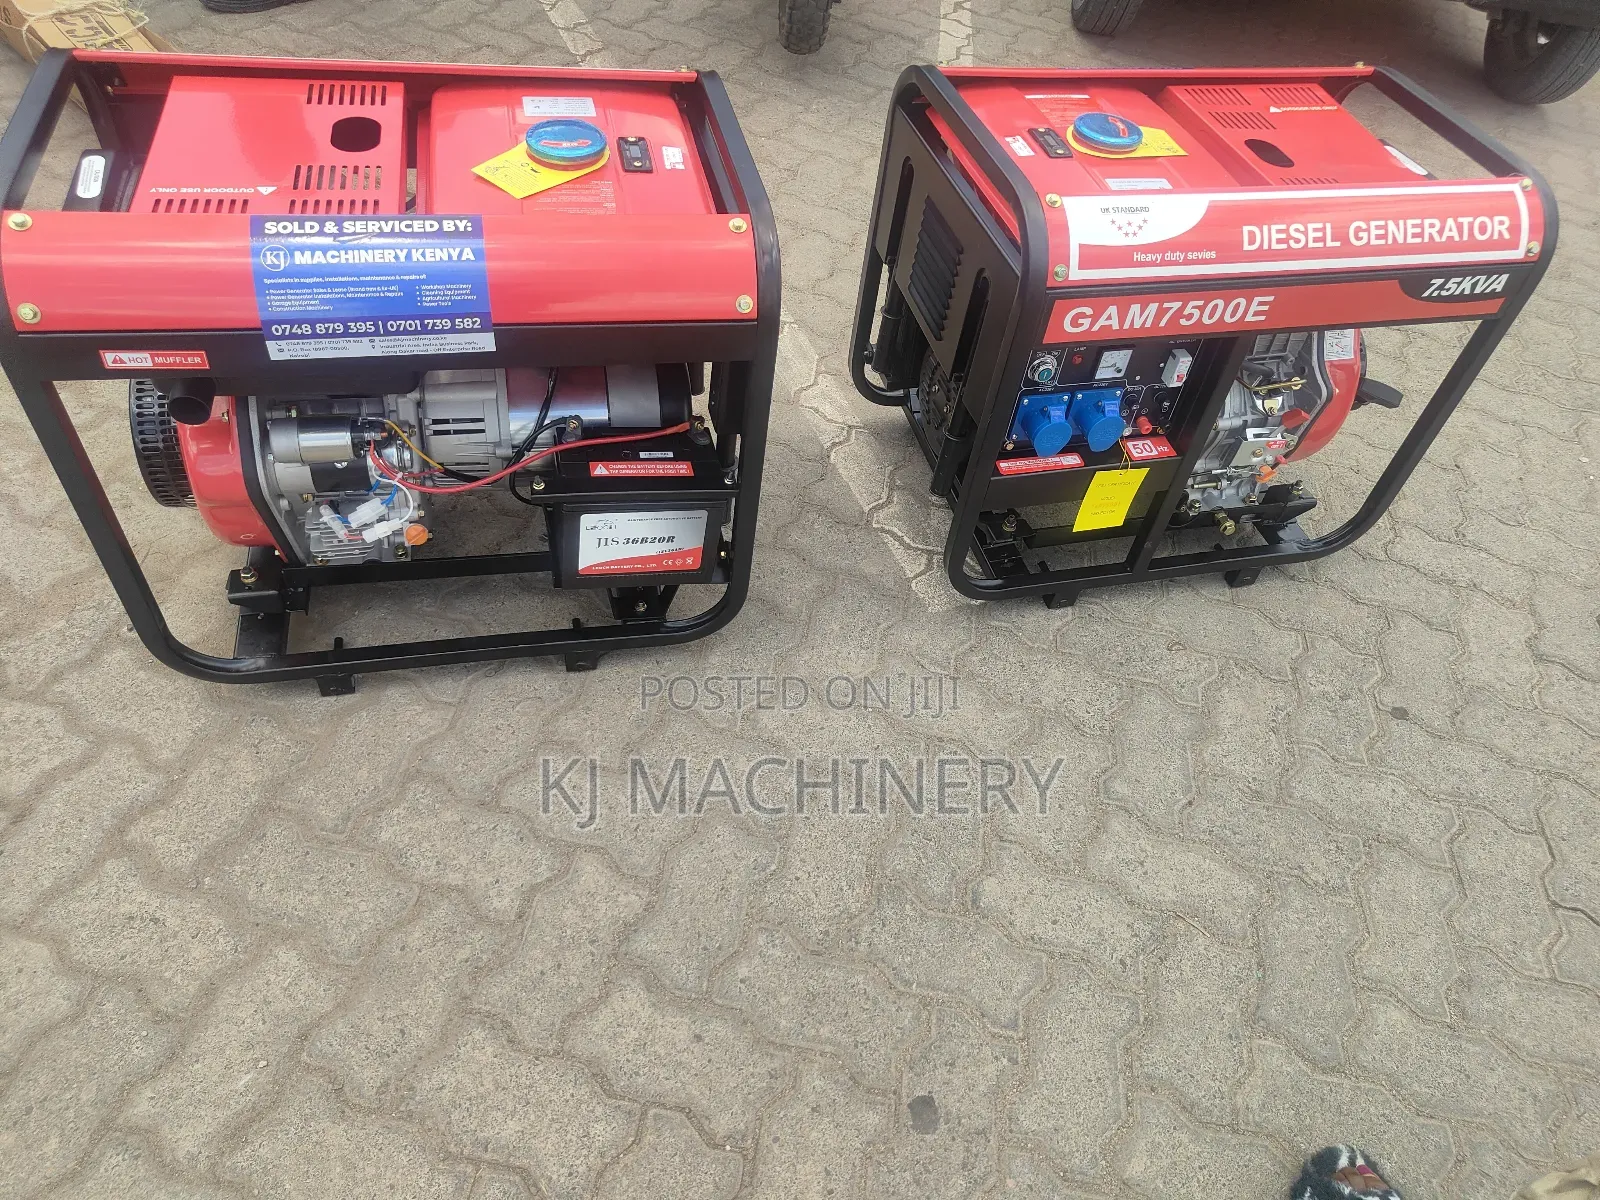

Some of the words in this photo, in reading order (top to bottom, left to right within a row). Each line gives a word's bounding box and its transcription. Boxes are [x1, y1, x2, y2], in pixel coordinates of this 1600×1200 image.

[1111, 206, 1150, 214] STANDARD
[264, 221, 320, 234] SOLD
[324, 220, 340, 233] &
[343, 219, 439, 233] SERVICED
[443, 219, 472, 232] BY:
[1242, 222, 1341, 251] DIESEL
[1348, 215, 1511, 246] GENERATOR
[265, 251, 286, 269] KJ
[294, 249, 408, 265] MACHINERY
[412, 247, 475, 262] KENYA
[1133, 251, 1162, 263] Heavy
[1164, 250, 1185, 262] duty
[1187, 248, 1216, 260] sevies
[1421, 273, 1510, 298] 7.5KVA
[1063, 295, 1275, 333] GAM7500E
[271, 324, 312, 336] 0748
[315, 323, 344, 334] 879
[348, 322, 375, 333] 395
[379, 320, 383, 334] |
[387, 320, 421, 331] 0701
[424, 319, 451, 330] 739
[455, 317, 481, 329] 582
[1131, 442, 1155, 455] 50
[1157, 445, 1170, 453] Hz
[596, 537, 619, 549] JIS
[622, 535, 676, 545] 36B20R
